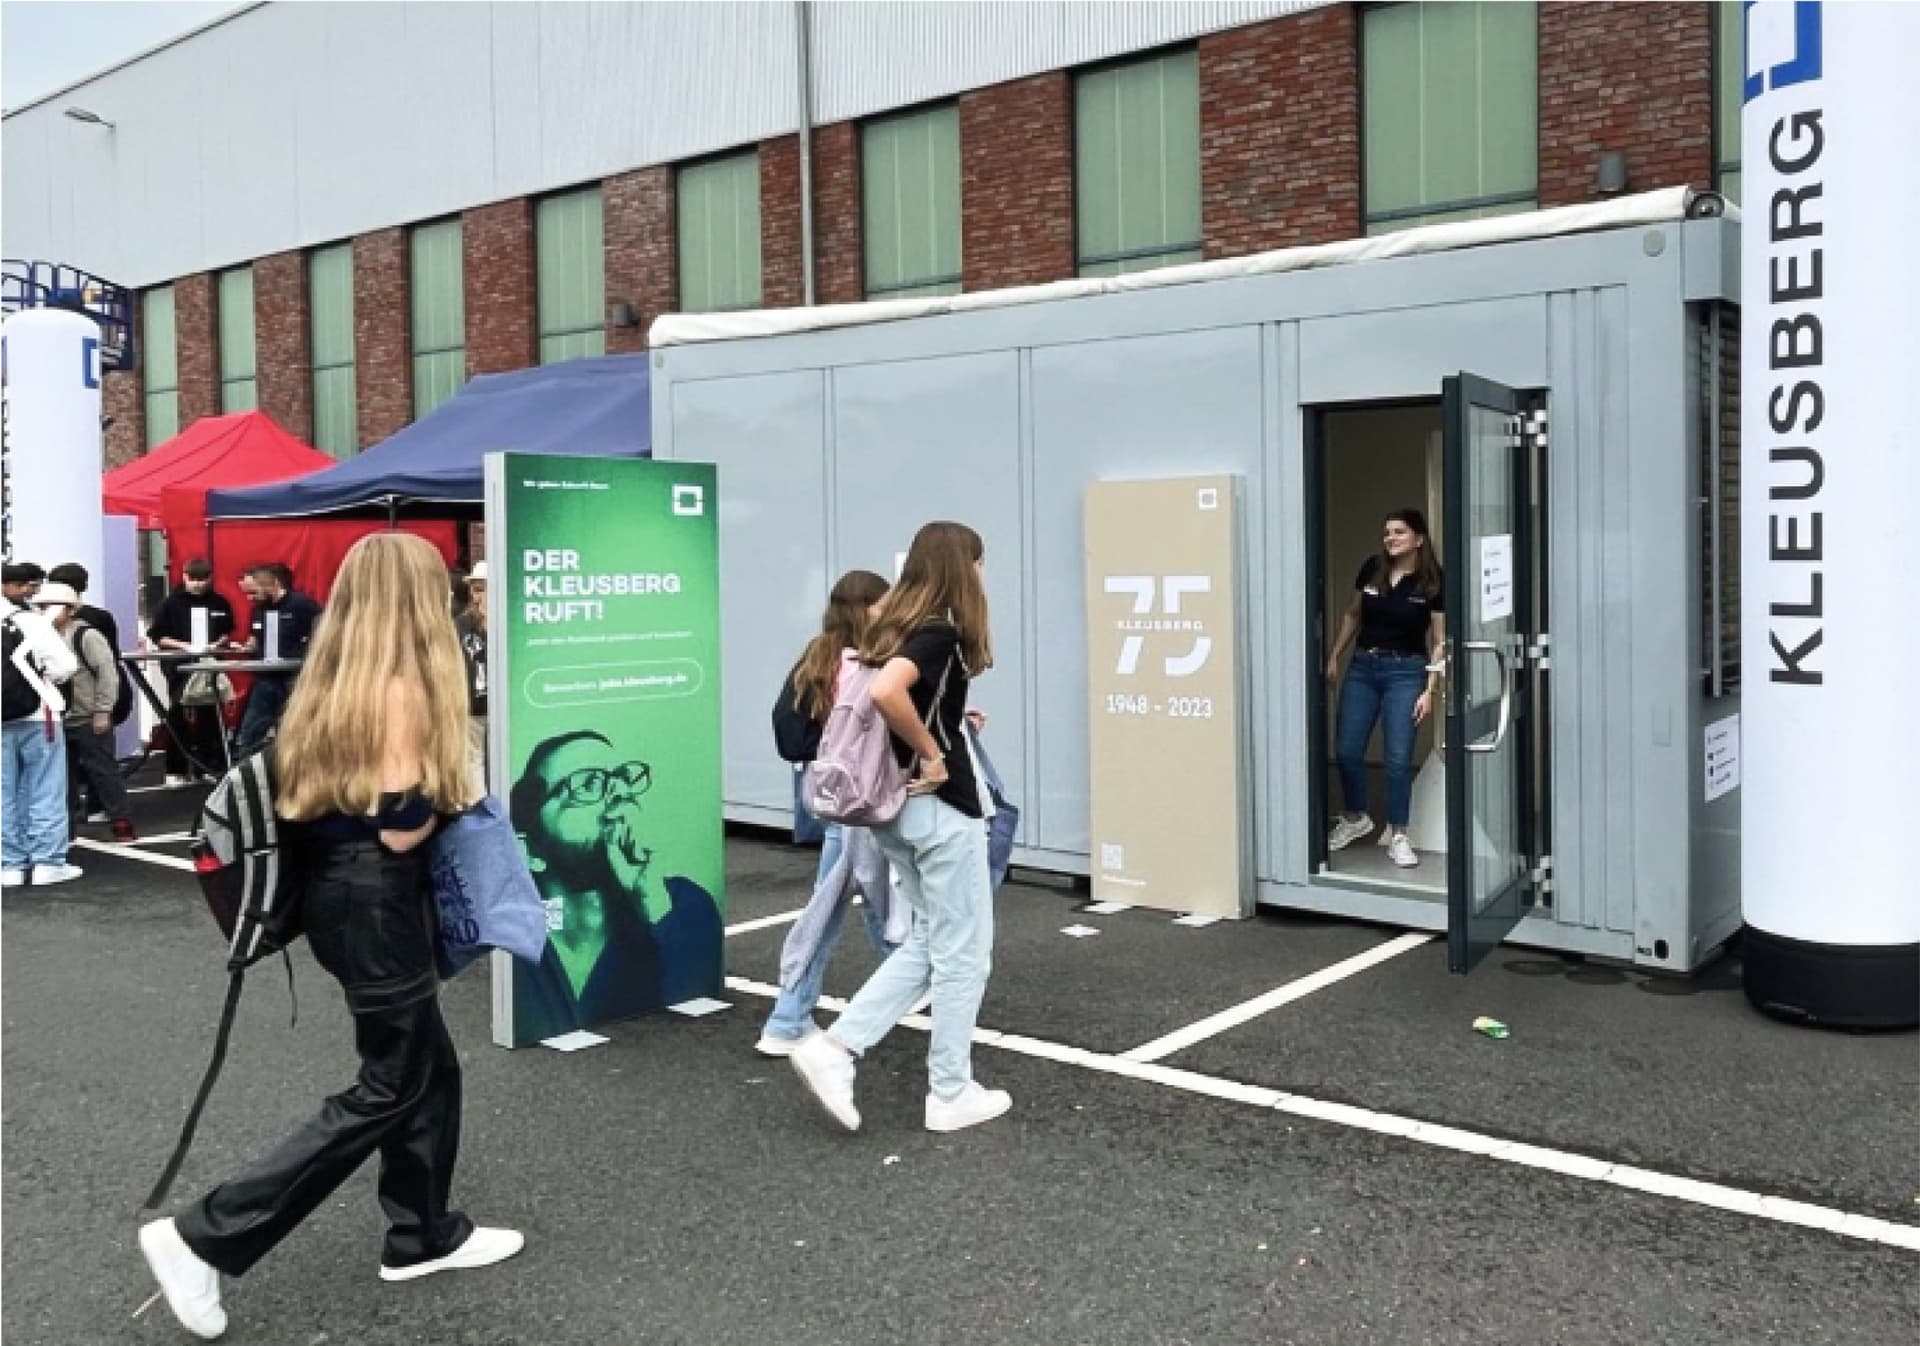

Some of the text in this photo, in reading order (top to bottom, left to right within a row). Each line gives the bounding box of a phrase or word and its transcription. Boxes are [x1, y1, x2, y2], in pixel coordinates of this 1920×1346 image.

[1769, 108, 1825, 686] KLEUSBERG
[523, 549, 580, 571] DER
[523, 573, 681, 598] KLEUSBERG
[525, 600, 605, 625] RUFT!
[1104, 575, 1212, 676] 75
[1105, 694, 1148, 714] 1948
[1167, 696, 1213, 719] 2023
